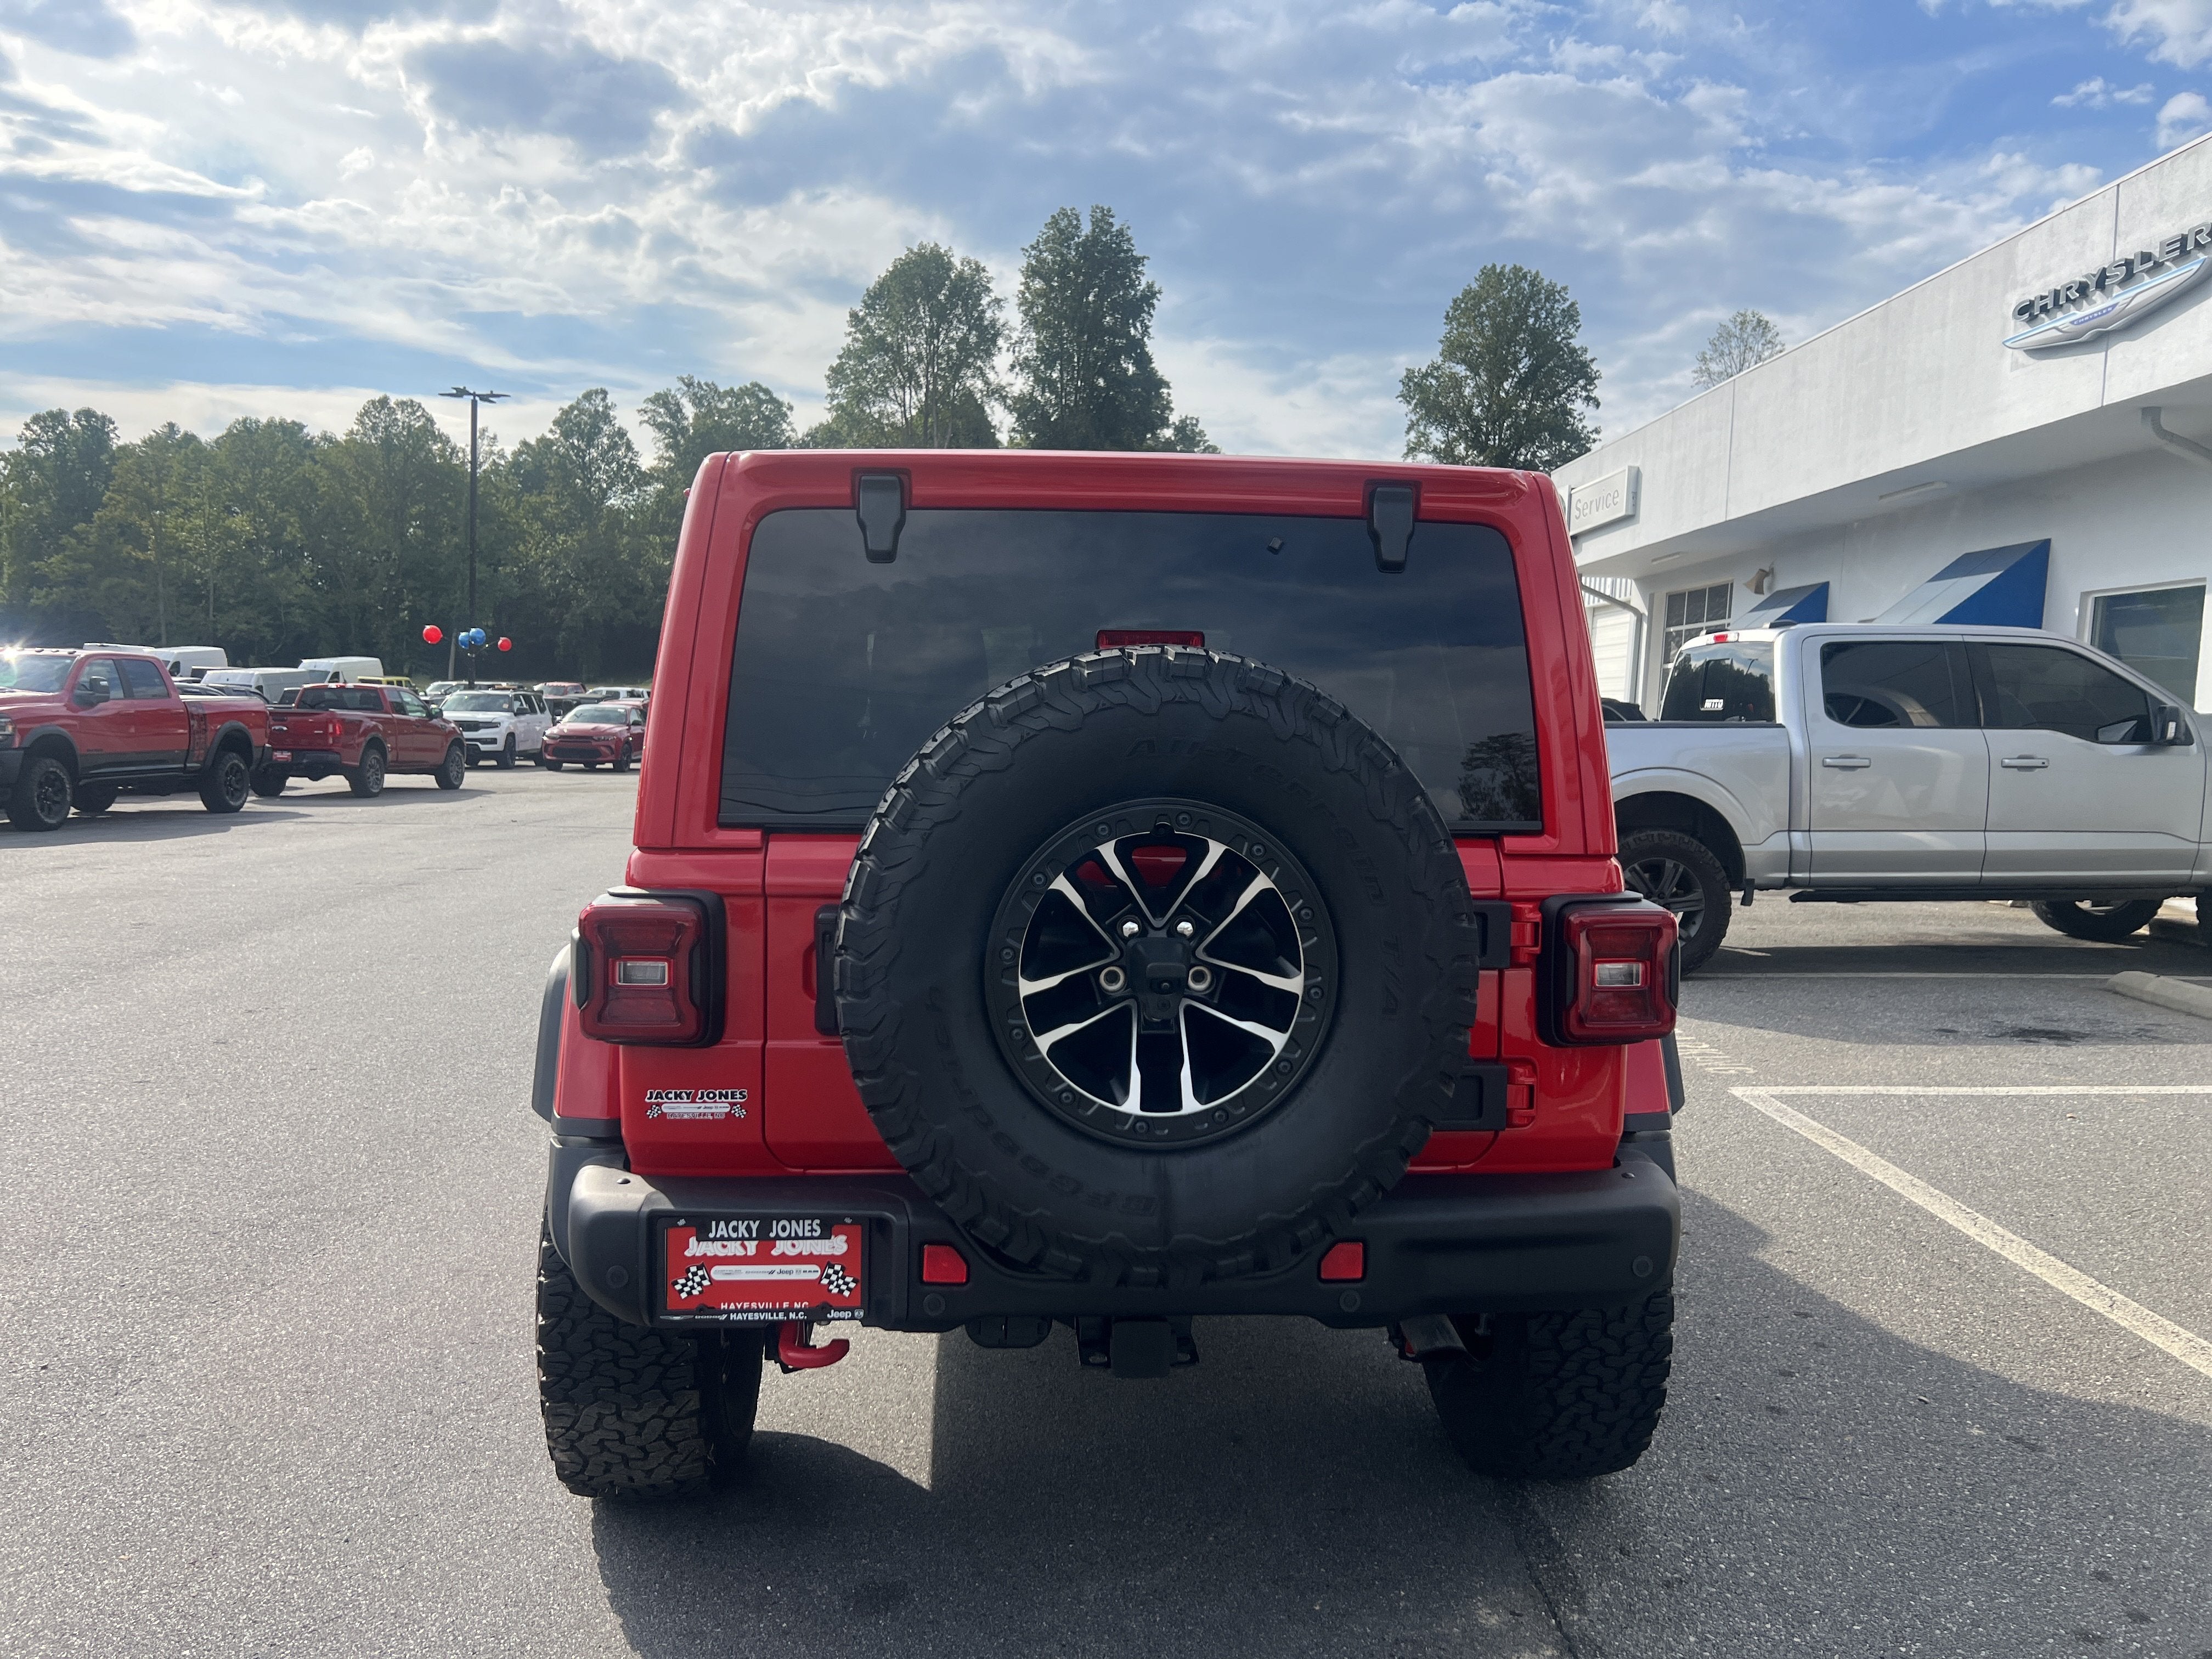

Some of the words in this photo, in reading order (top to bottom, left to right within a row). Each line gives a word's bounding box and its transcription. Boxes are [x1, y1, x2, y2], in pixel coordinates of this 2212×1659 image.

[2012, 221, 2212, 321] CHRYSLER
[1575, 489, 1619, 520] Service
[645, 1090, 694, 1102] JACKY
[696, 1089, 747, 1102] JONES
[708, 1220, 760, 1238] JACKY
[769, 1219, 821, 1238] JONES
[684, 1236, 759, 1256] JACKY
[771, 1234, 848, 1256] JONES
[730, 1312, 786, 1321] HAYESVILLE,
[789, 1311, 807, 1320] N.C.
[827, 1309, 851, 1319] Jeep
